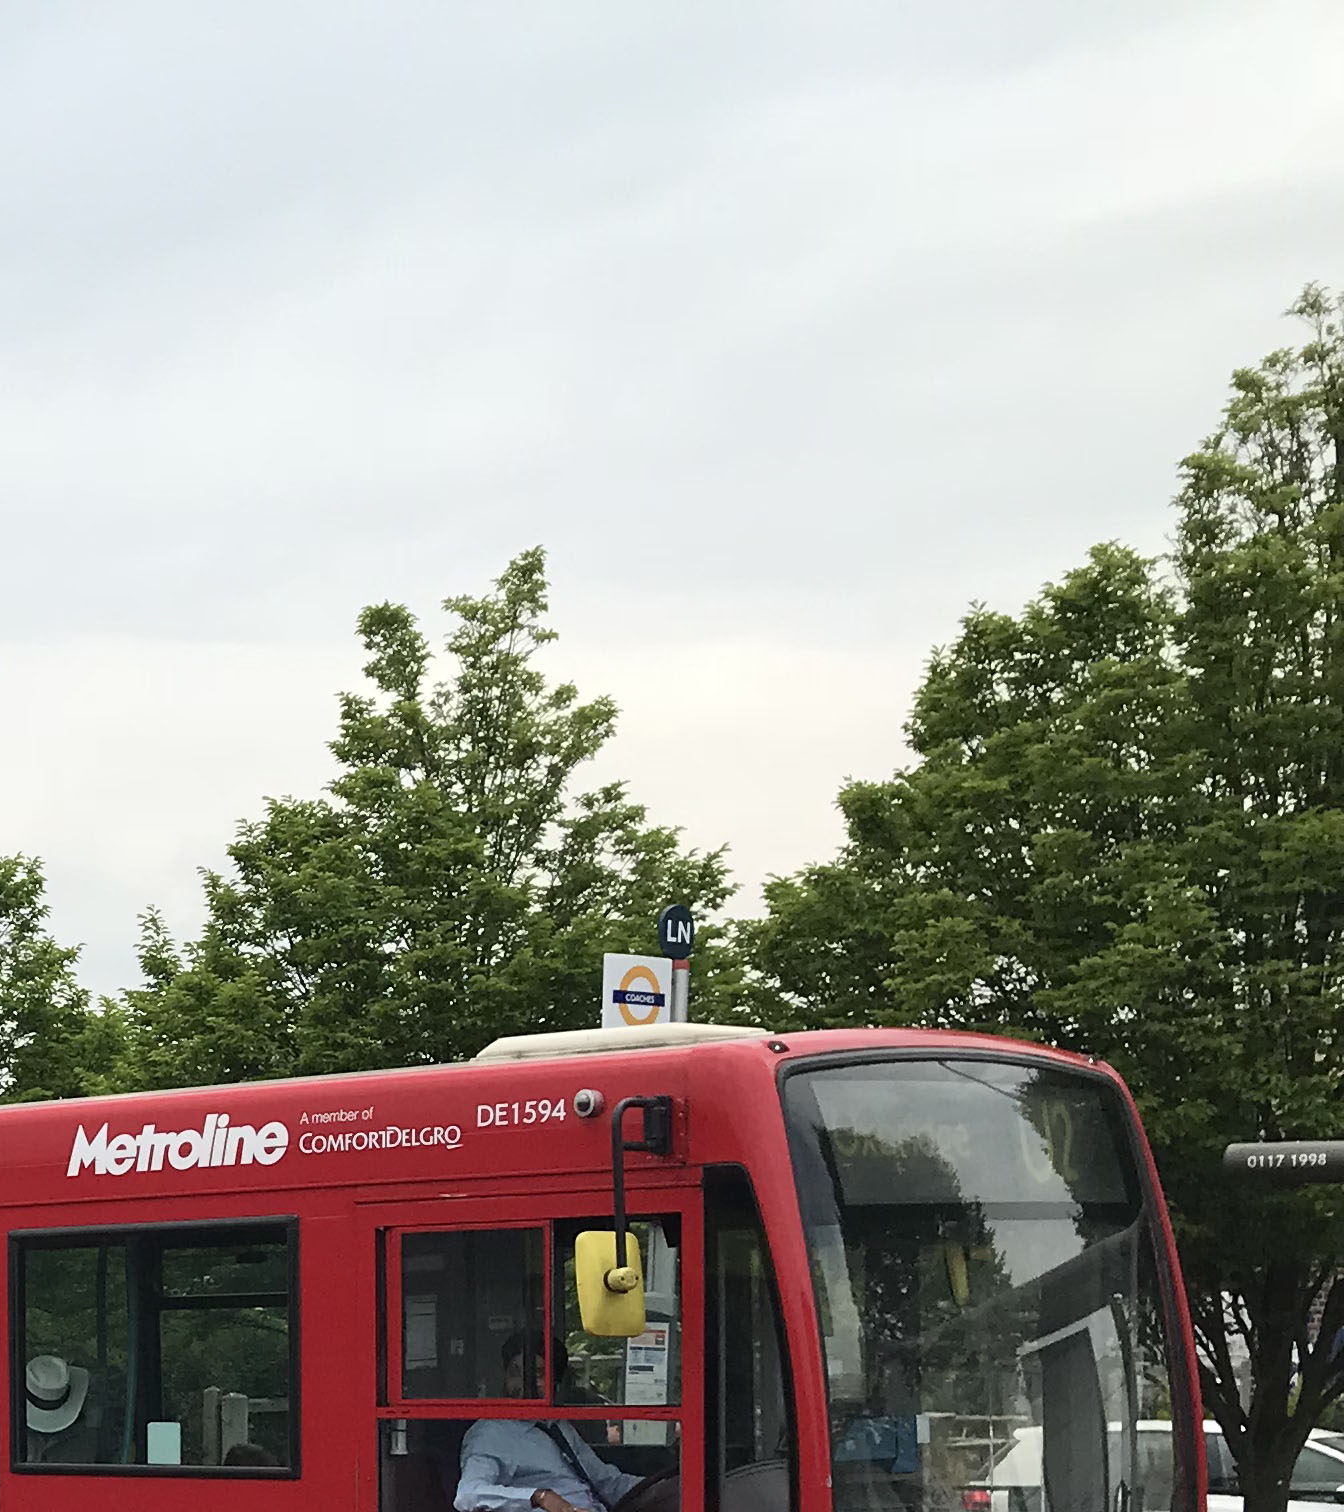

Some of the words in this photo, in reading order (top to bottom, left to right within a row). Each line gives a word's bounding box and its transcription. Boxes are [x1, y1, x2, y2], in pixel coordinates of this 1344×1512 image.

[666, 919, 692, 944] LN
[625, 992, 655, 1005] COACHES
[299, 1112, 311, 1125] A
[313, 1109, 359, 1125] member
[361, 1105, 375, 1121] of
[477, 1098, 567, 1129] DE1594
[67, 1113, 289, 1178] Metroline
[1246, 1153, 1284, 1169] 0117
[1289, 1151, 1328, 1168] 1998
